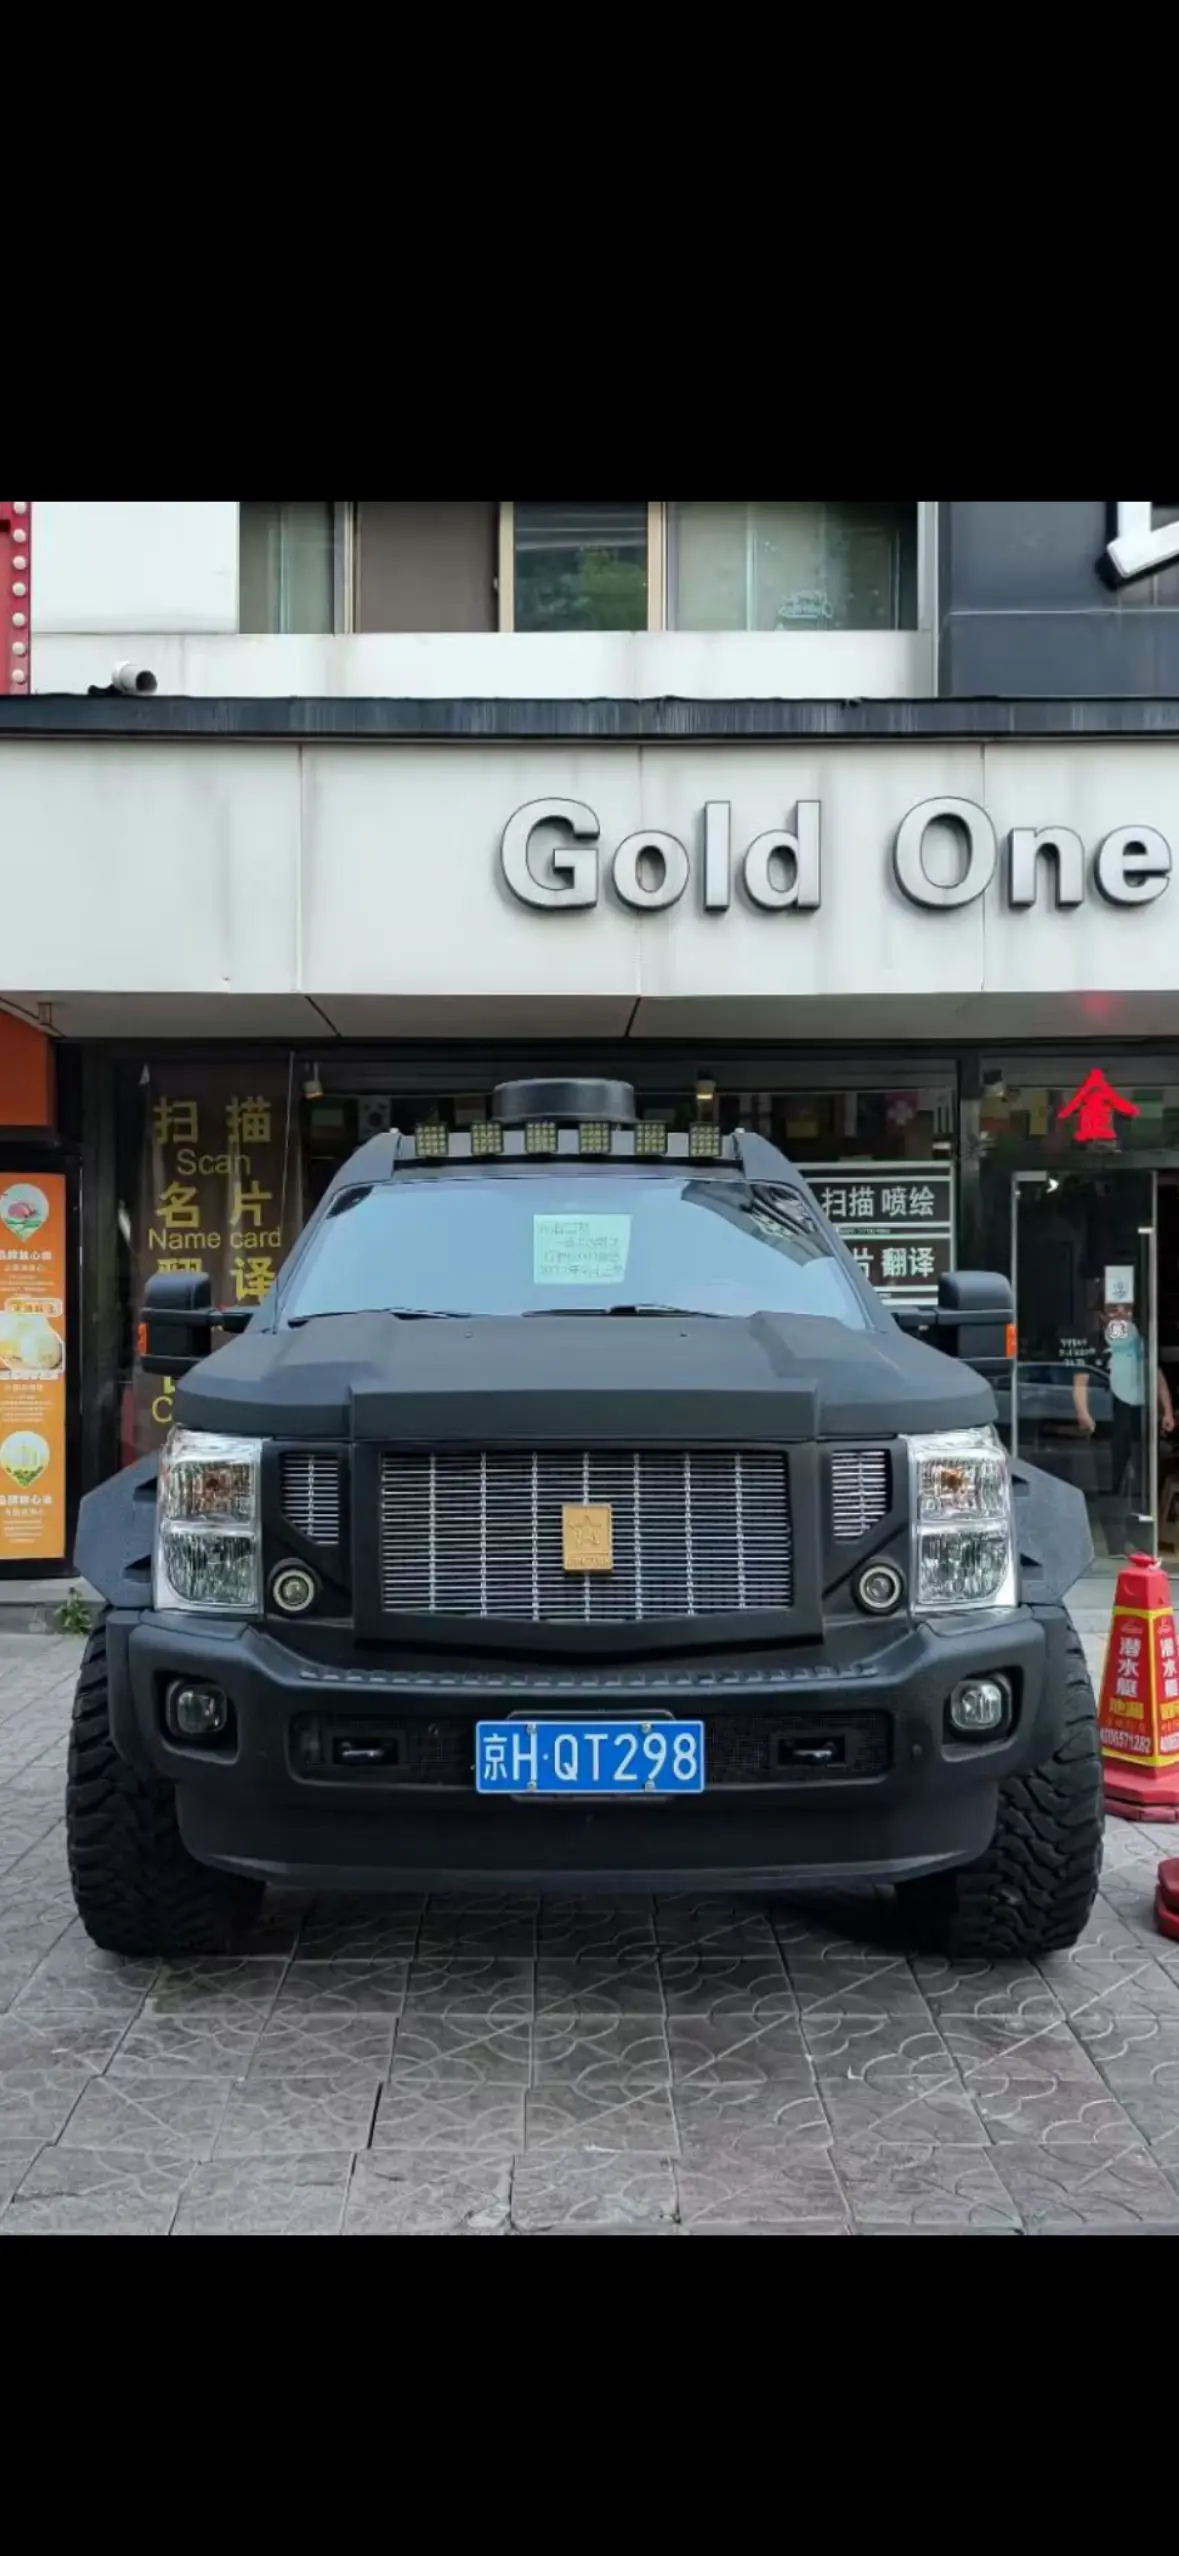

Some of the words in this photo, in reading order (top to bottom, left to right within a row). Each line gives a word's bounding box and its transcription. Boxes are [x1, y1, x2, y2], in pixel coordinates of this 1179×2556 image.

[500, 796, 822, 912] Gold
[892, 795, 1173, 911] One
[153, 1096, 271, 1144] 扫描
[1058, 1067, 1140, 1142] 金
[176, 1149, 250, 1175] Scan
[156, 1180, 272, 1229] 名片
[821, 1186, 875, 1217] 扫描
[881, 1185, 935, 1217] 喷绘
[149, 1228, 221, 1250] Name
[230, 1225, 281, 1249] card
[881, 1247, 935, 1278] 翻译
